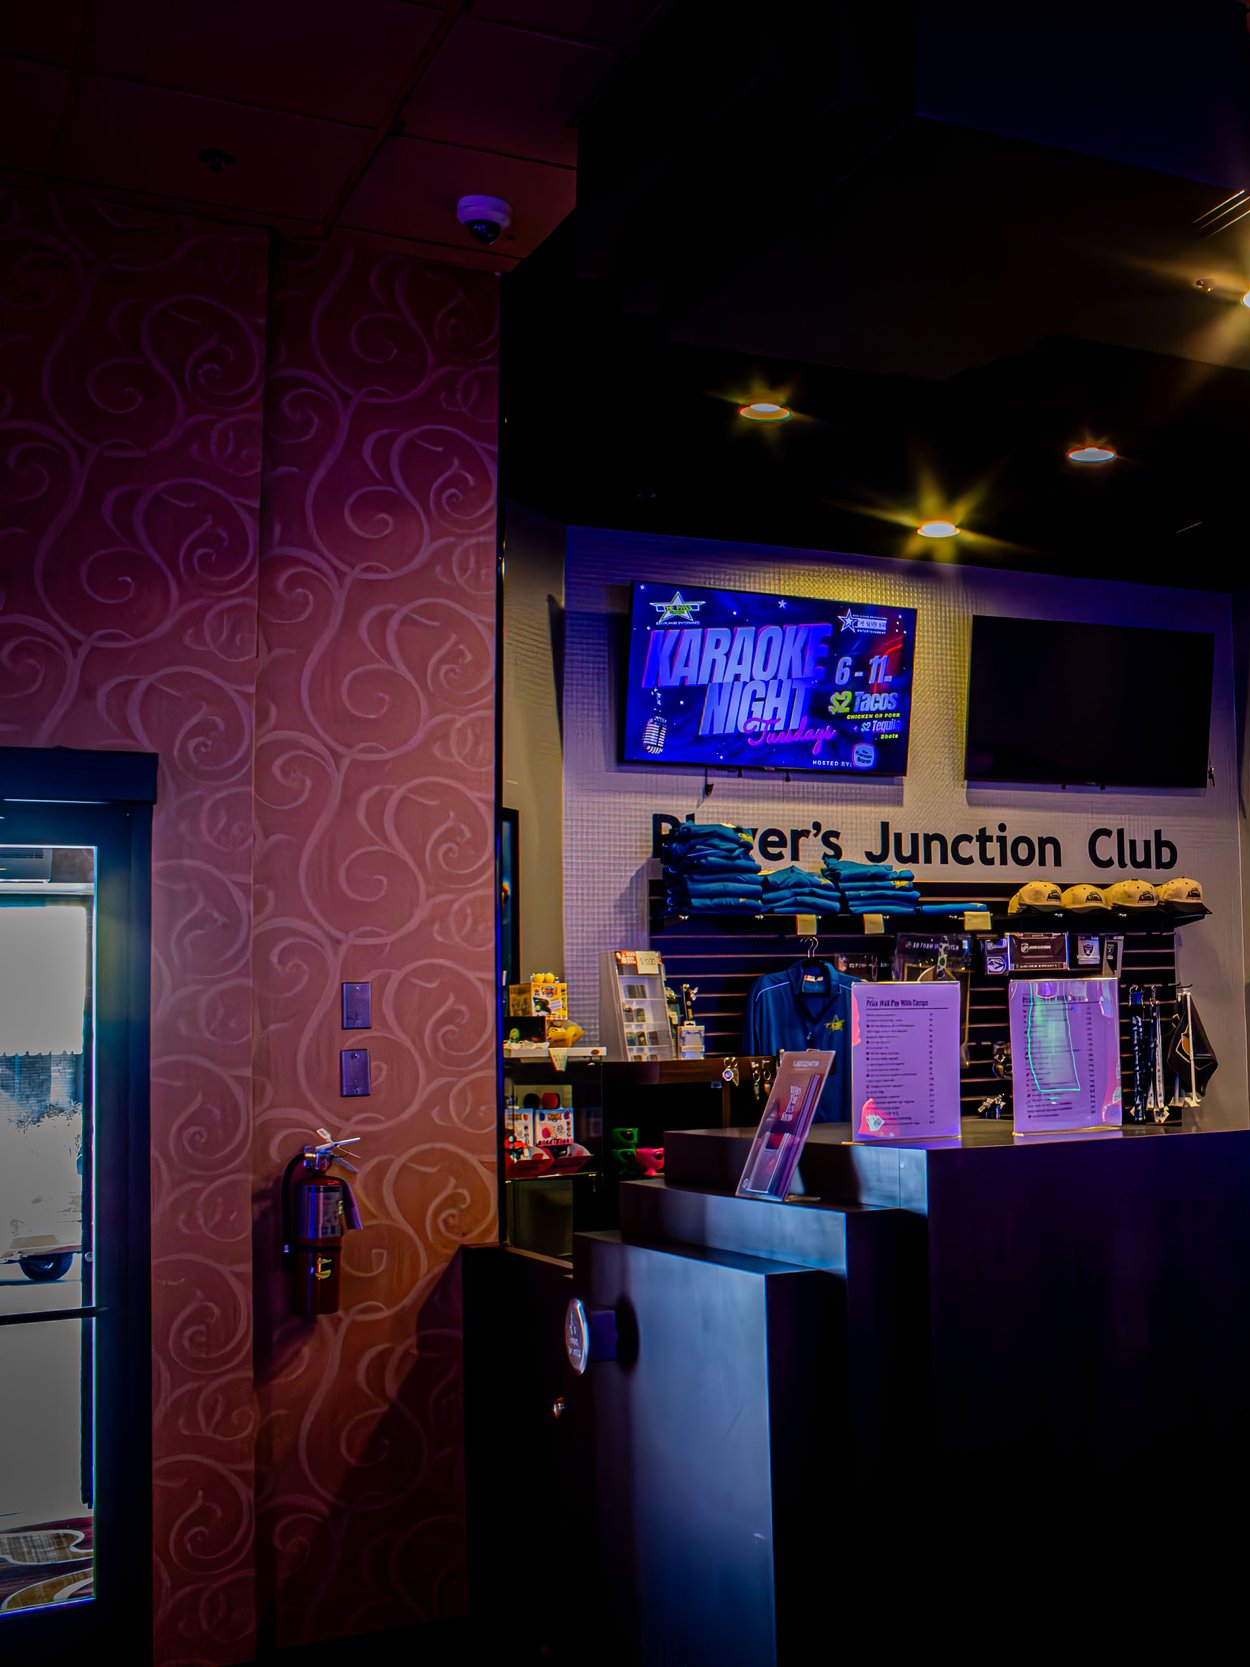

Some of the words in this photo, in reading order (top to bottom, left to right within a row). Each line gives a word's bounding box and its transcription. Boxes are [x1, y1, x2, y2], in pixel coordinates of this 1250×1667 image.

[642, 624, 832, 689] KARAOKE
[835, 656, 853, 686] 6
[698, 678, 811, 735] NIGHT
[829, 690, 853, 715] $2
[853, 691, 899, 712] Tacos
[743, 716, 837, 755] Tuesdays
[864, 820, 1062, 869] Junction
[1088, 827, 1178, 870] Club
